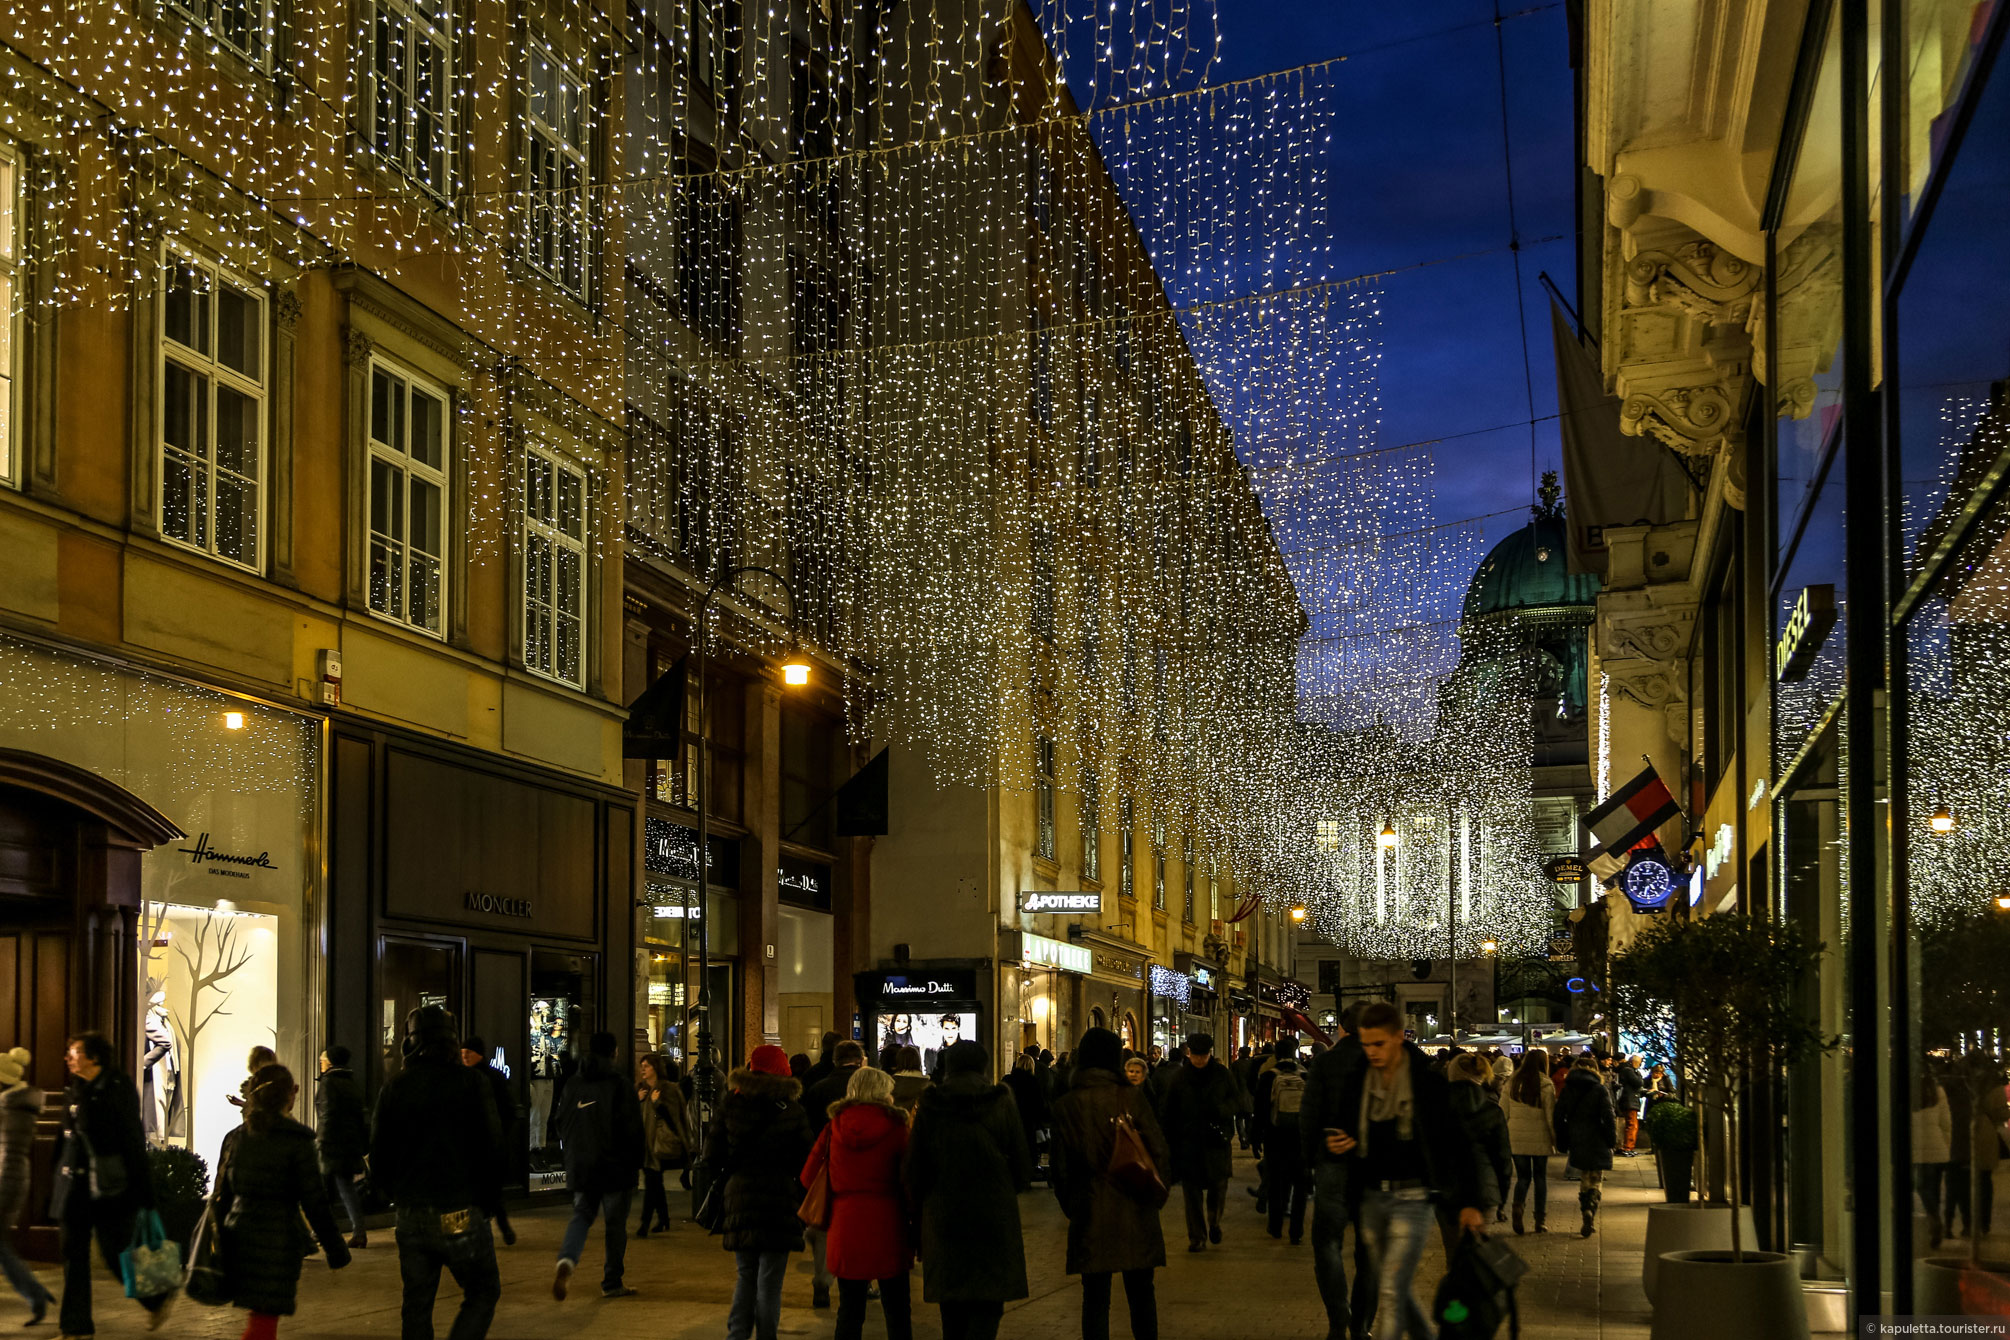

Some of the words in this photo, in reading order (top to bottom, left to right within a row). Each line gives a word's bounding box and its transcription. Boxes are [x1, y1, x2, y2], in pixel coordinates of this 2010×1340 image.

[1776, 586, 1812, 681] DIESEL
[208, 867, 220, 876] DAS
[220, 869, 250, 879] MODEHAUS
[1554, 864, 1584, 873] DEMEL
[468, 892, 533, 918] MONCLER
[1025, 893, 1099, 910] APOTHEKE
[1034, 939, 1090, 971] APOTHEKE
[882, 981, 926, 995] Massimo
[927, 980, 955, 994] Dutti
